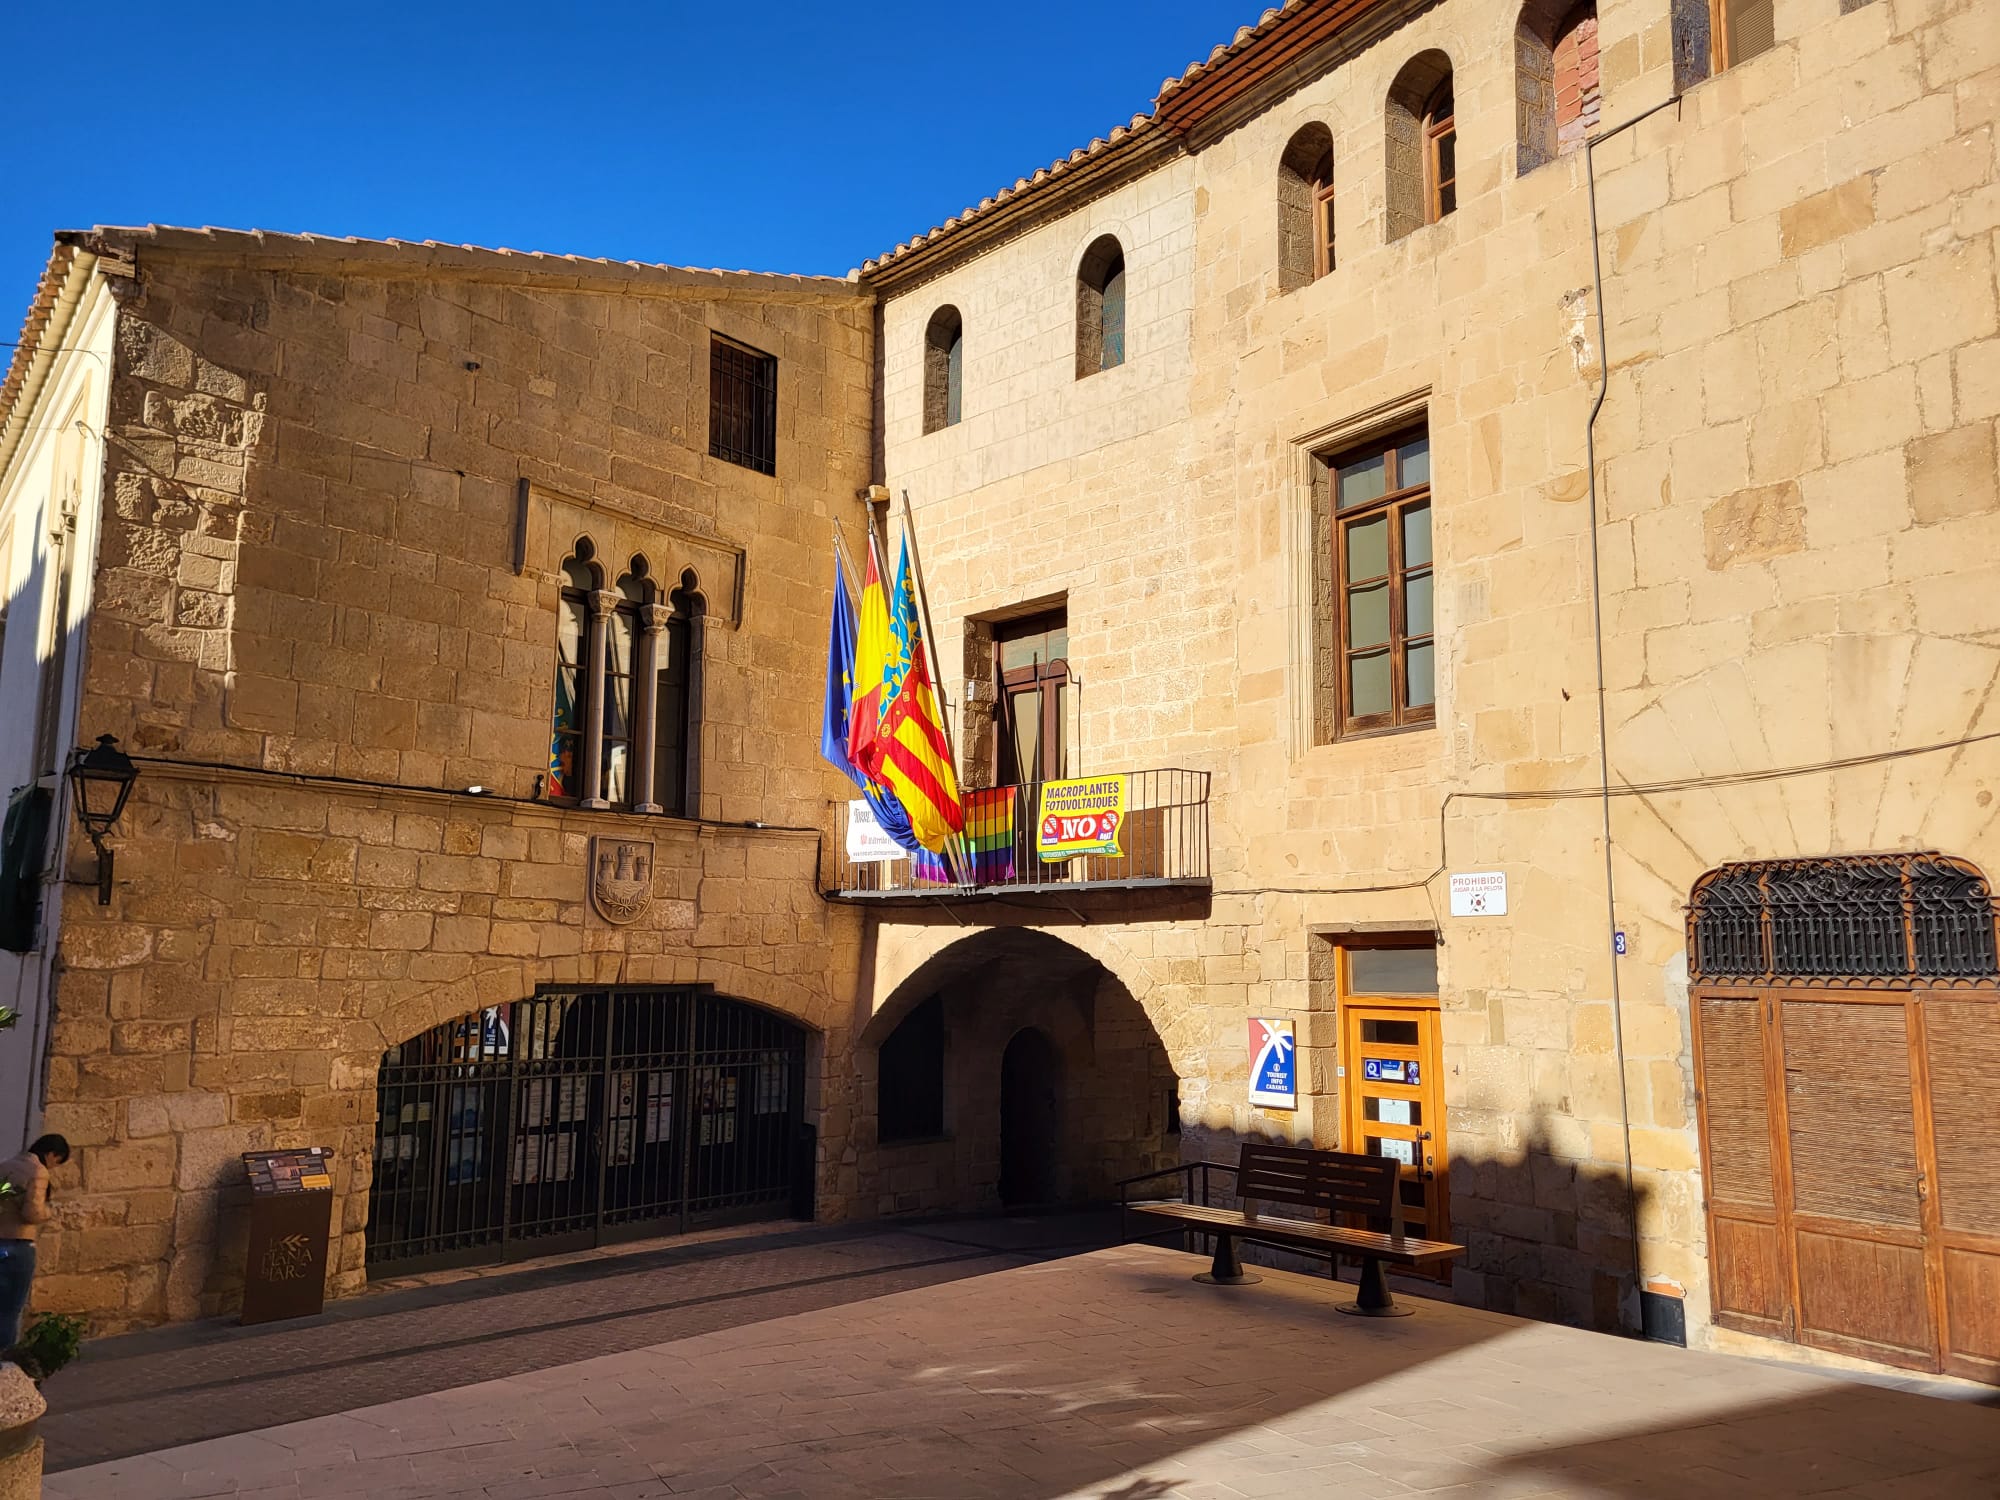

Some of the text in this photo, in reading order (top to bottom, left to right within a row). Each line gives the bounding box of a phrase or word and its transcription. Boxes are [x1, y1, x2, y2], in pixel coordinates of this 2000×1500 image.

[1047, 782, 1119, 799] MACROPLANTES
[1045, 795, 1117, 811] FOTOVOLTAIQUES
[1061, 817, 1096, 839] NO
[1453, 876, 1503, 886] PROHIBIDO
[1616, 934, 1624, 952] 3
